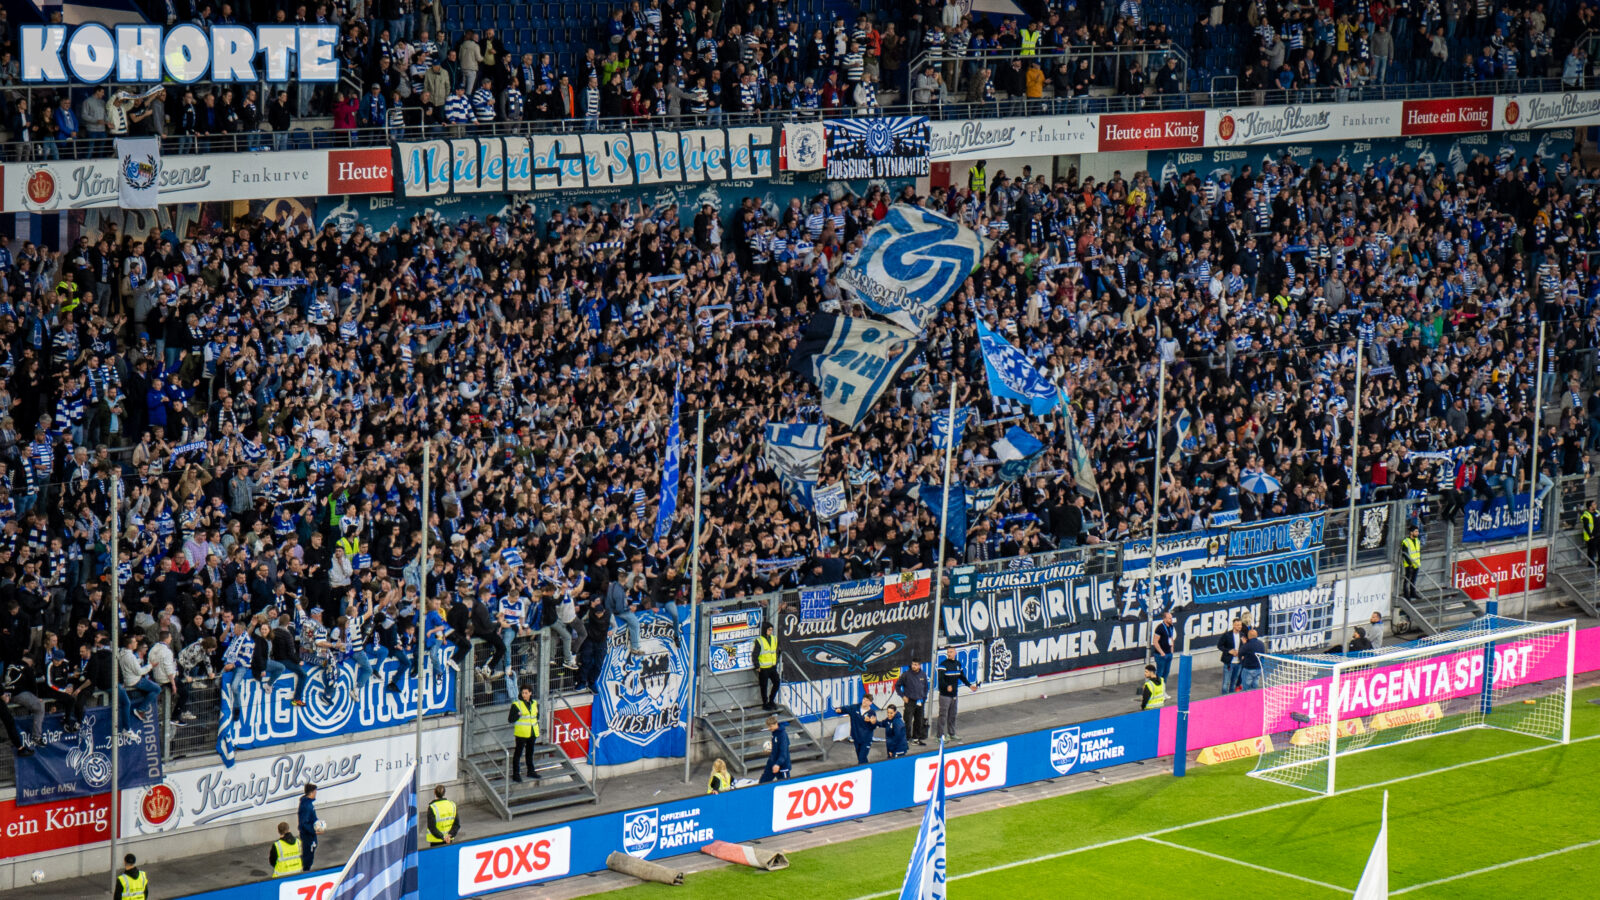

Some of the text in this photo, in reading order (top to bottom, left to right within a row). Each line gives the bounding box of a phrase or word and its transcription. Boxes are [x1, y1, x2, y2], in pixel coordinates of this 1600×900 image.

[1342, 114, 1391, 127] Fankurve
[1408, 107, 1489, 127] Heute ein König
[1030, 130, 1085, 143] Fankurve
[1105, 122, 1200, 143] Heute ein König
[232, 169, 309, 184] Fankurve
[338, 161, 387, 181] Heute
[827, 154, 930, 180] DUISBURG DYNAMITES
[1191, 557, 1316, 598] WEDAUSTADION
[1454, 571, 1489, 589] Heute
[1271, 586, 1334, 611] RUHRPOTT
[783, 601, 930, 637] Proud Generation
[1018, 629, 1100, 668] IMMER
[1328, 662, 1448, 716] MAGENTA
[1385, 712, 1422, 728] Sinalco
[554, 722, 589, 745] Heu
[1081, 727, 1115, 740] OFFIZIELLER
[1080, 736, 1114, 752] TEAM-
[1212, 743, 1251, 763] Sinalco
[1080, 745, 1125, 765] PARTNER
[23, 781, 77, 798] Nur der MSV
[785, 779, 855, 821] ZOXS
[6, 803, 109, 837] ein König
[660, 807, 701, 822] OFFIZIELLER
[660, 818, 700, 837] TEAM-
[660, 828, 714, 850] PARTNER
[474, 838, 552, 884] ZOXS
